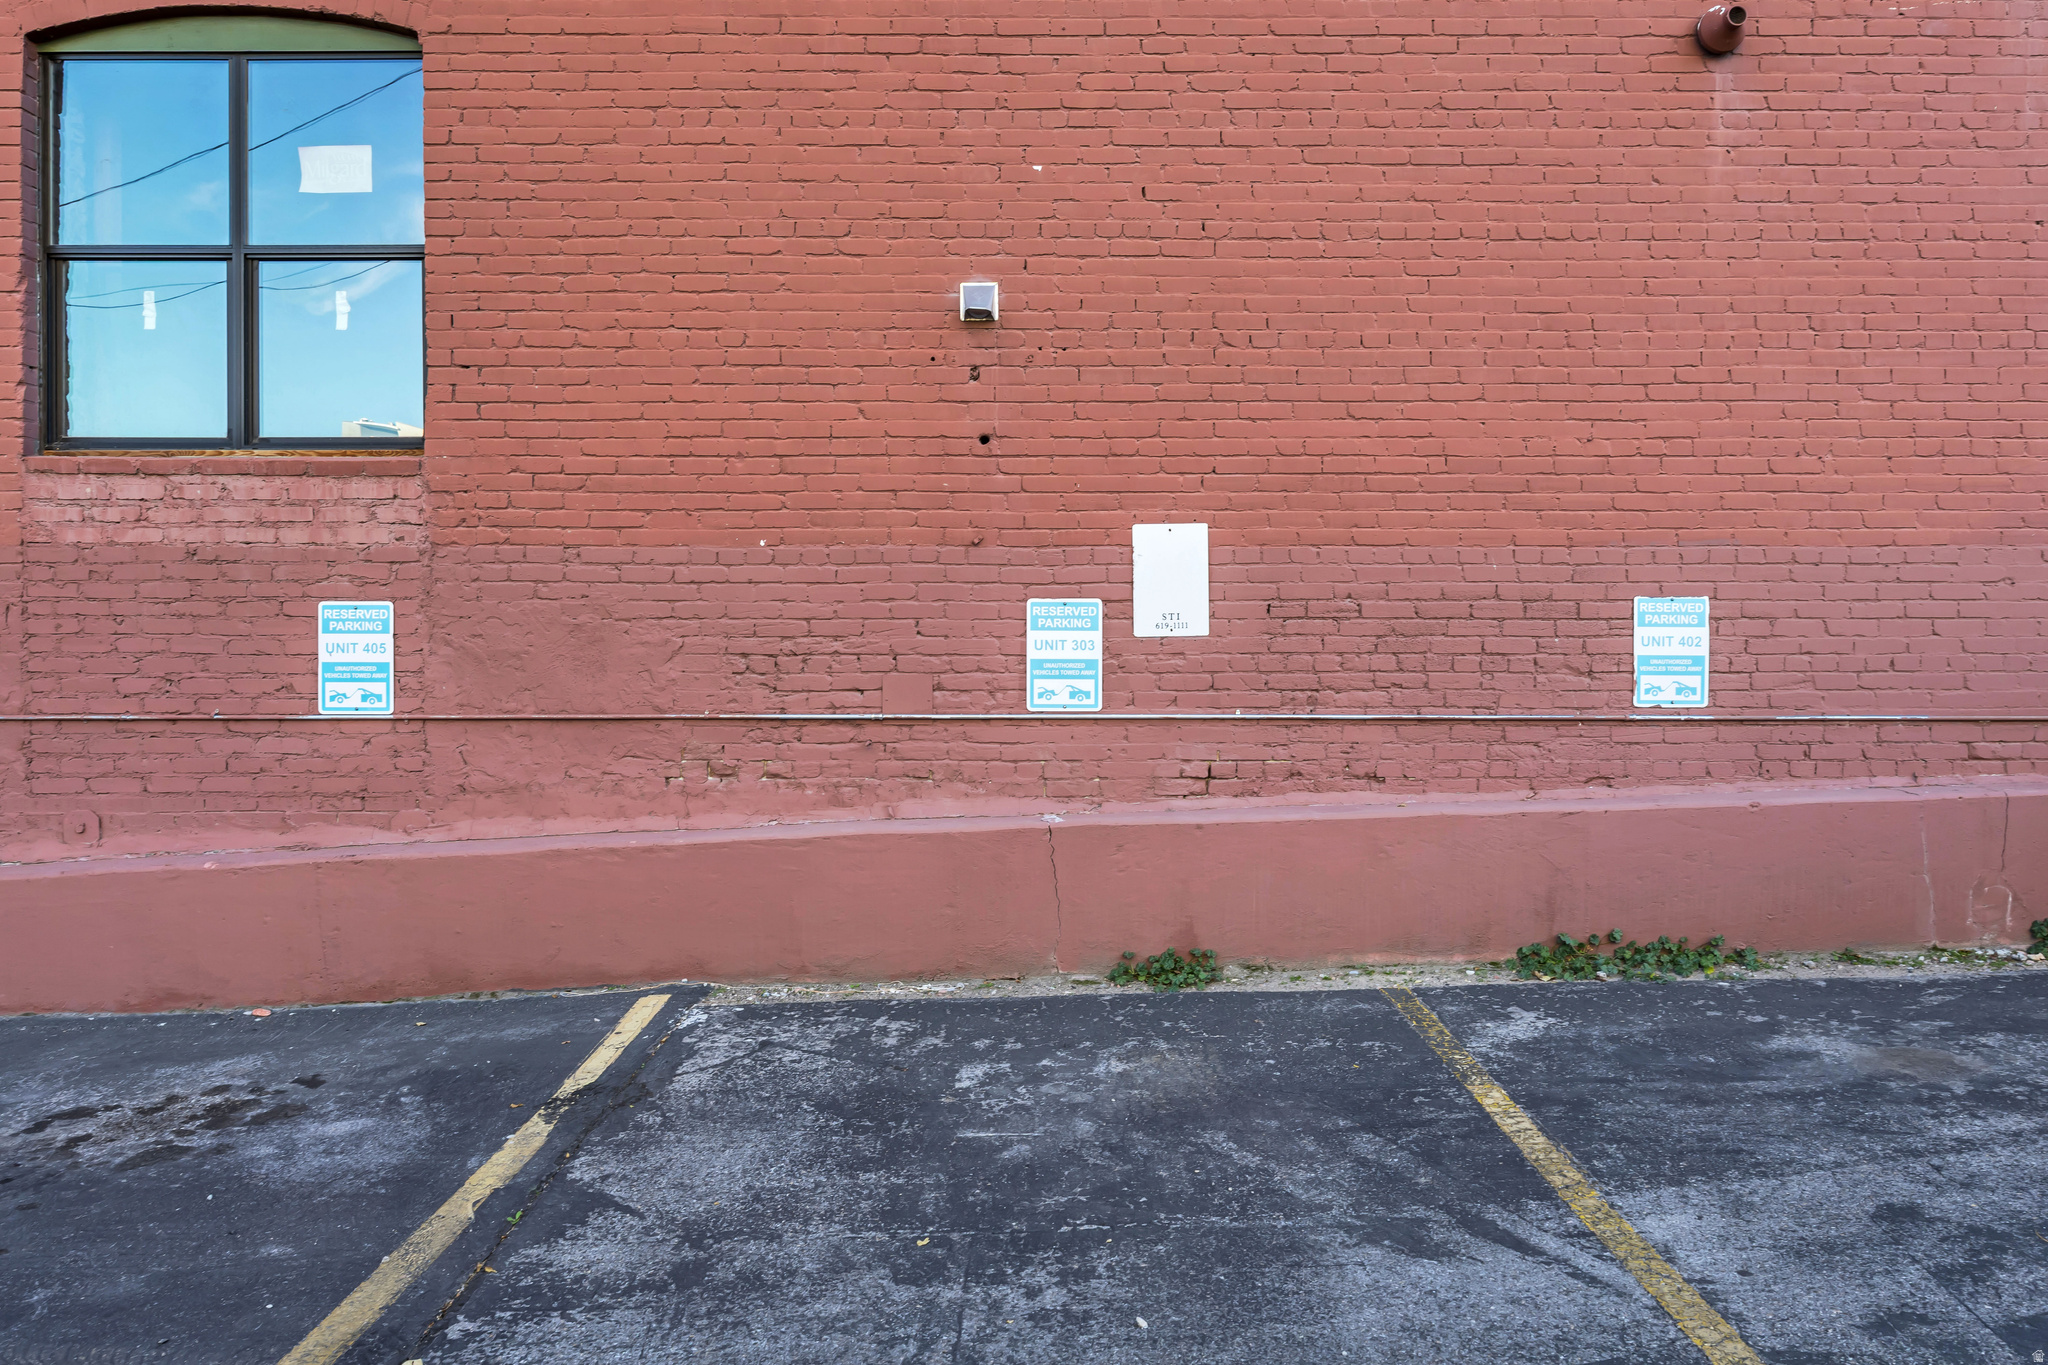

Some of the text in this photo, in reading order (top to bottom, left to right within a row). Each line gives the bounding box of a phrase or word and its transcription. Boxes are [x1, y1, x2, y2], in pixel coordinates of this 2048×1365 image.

[1032, 606, 1097, 616] RESERVED
[1640, 603, 1704, 613] RESERVED
[324, 609, 388, 619] RESERVED
[1162, 612, 1180, 621] STI
[1038, 618, 1092, 628] PARKING
[1645, 615, 1698, 625] PARKING
[329, 621, 383, 631] PARKING
[1034, 639, 1095, 651] UNIT 303
[1641, 636, 1702, 647] UNIT 402
[326, 642, 386, 654] UNIT 405
